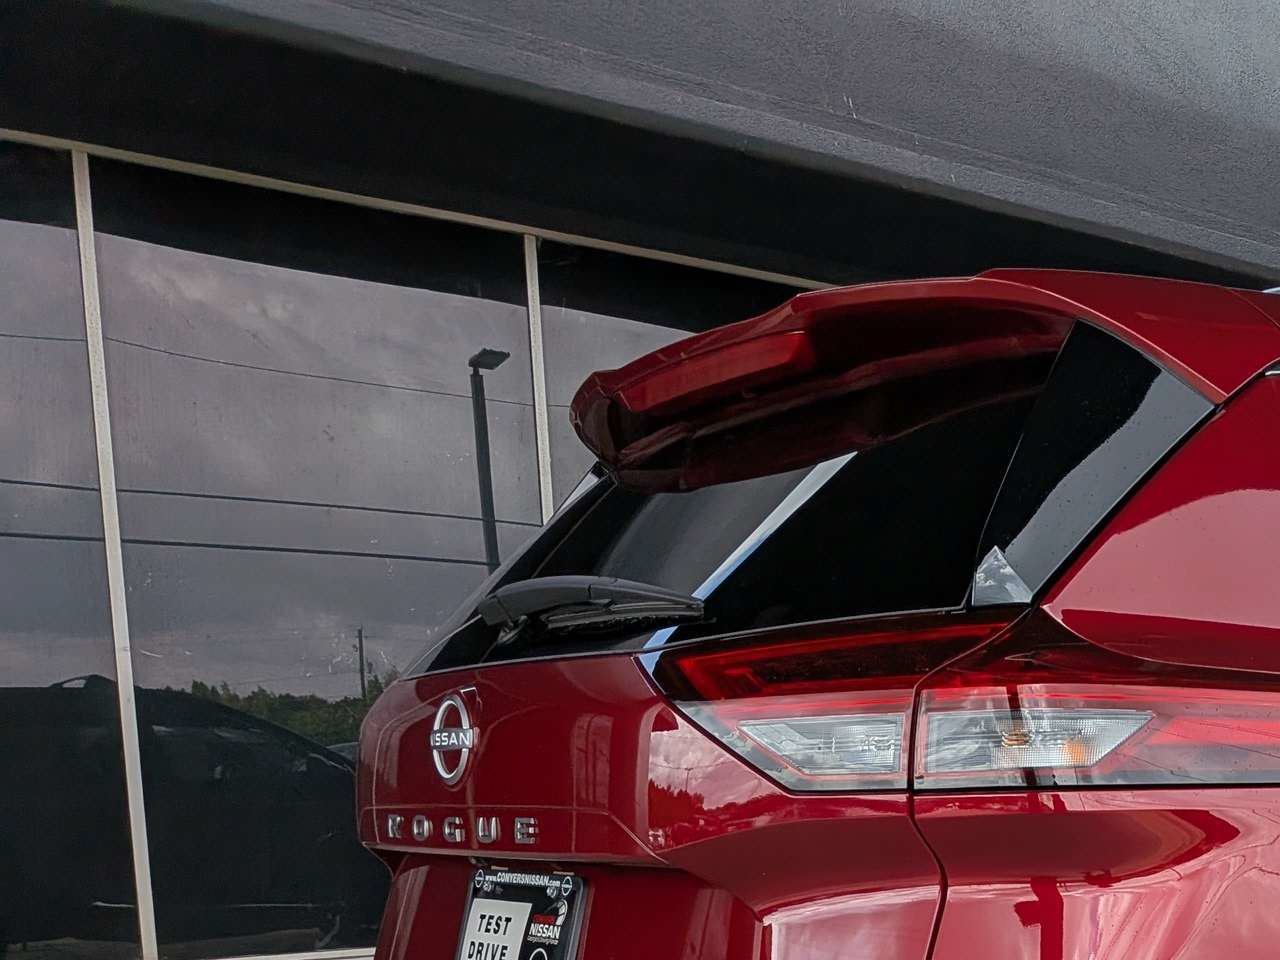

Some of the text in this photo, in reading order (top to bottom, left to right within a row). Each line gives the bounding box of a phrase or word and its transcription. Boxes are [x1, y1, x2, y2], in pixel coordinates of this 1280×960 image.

[387, 814, 537, 844] ROGUE
[478, 914, 512, 936] TEST
[529, 923, 561, 939] NISSAN
